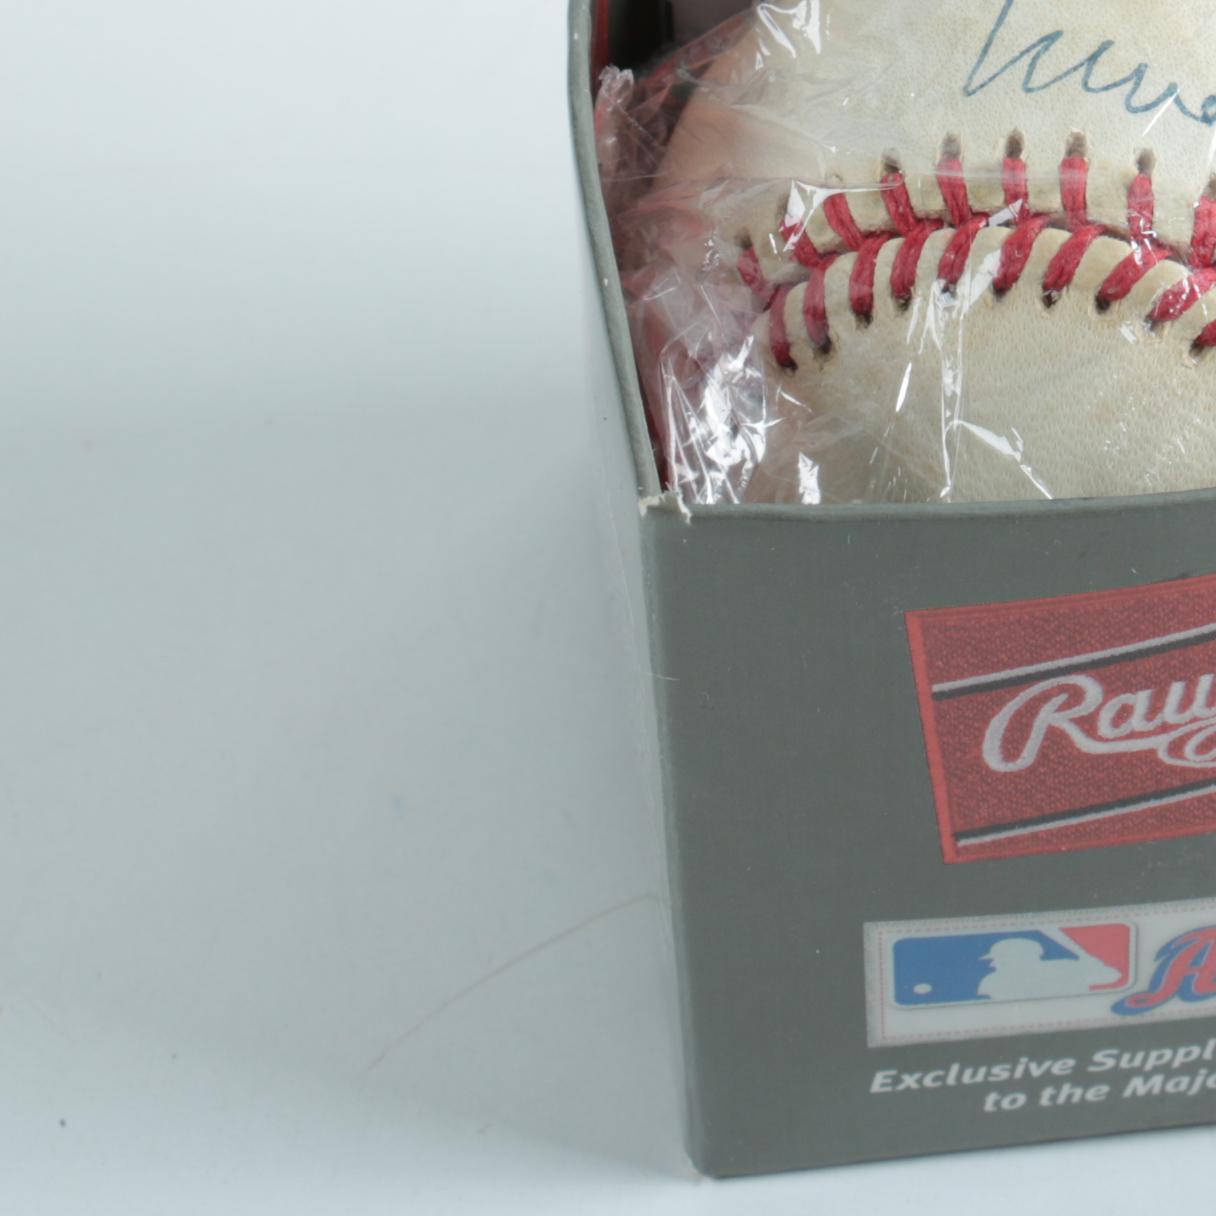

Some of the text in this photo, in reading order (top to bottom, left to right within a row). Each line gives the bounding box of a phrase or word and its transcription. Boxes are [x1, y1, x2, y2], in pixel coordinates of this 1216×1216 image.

[869, 1055, 1077, 1094] Exclusive
[983, 1090, 1027, 1113] to
[1038, 1083, 1111, 1108] the
